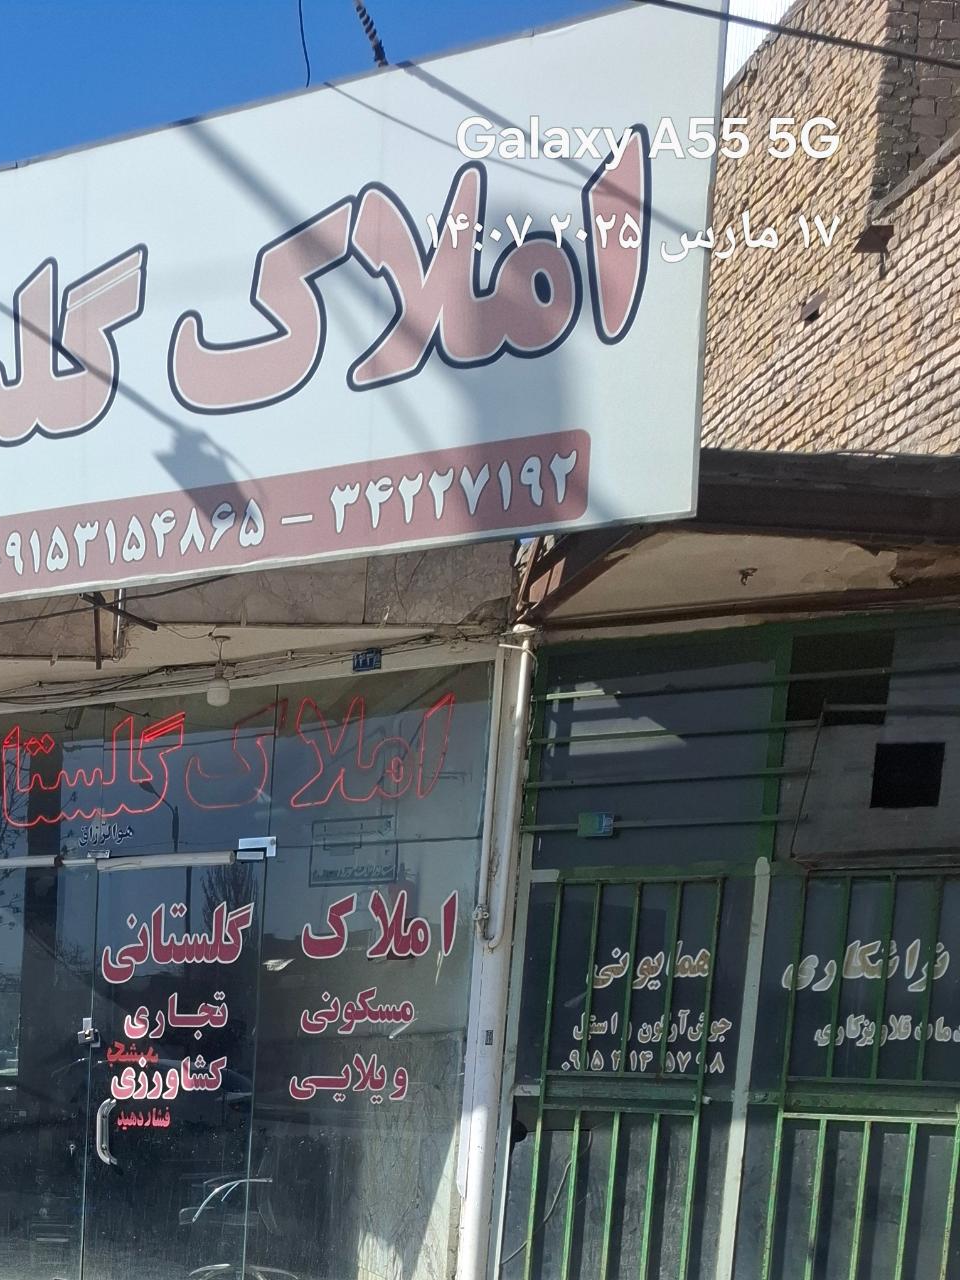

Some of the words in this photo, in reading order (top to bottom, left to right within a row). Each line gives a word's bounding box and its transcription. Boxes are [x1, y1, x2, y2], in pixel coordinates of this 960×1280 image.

[168, 125, 652, 414] املاک
[329, 448, 578, 534] ۳۴۲۲۷۱۹۲
[185, 693, 456, 809] املاک
[101, 901, 255, 985] گلستانی
[123, 991, 229, 1041] تجاری
[300, 986, 415, 1035] مسکونی
[111, 1054, 227, 1100] کشاورزی
[289, 1053, 410, 1104] ویلایی
